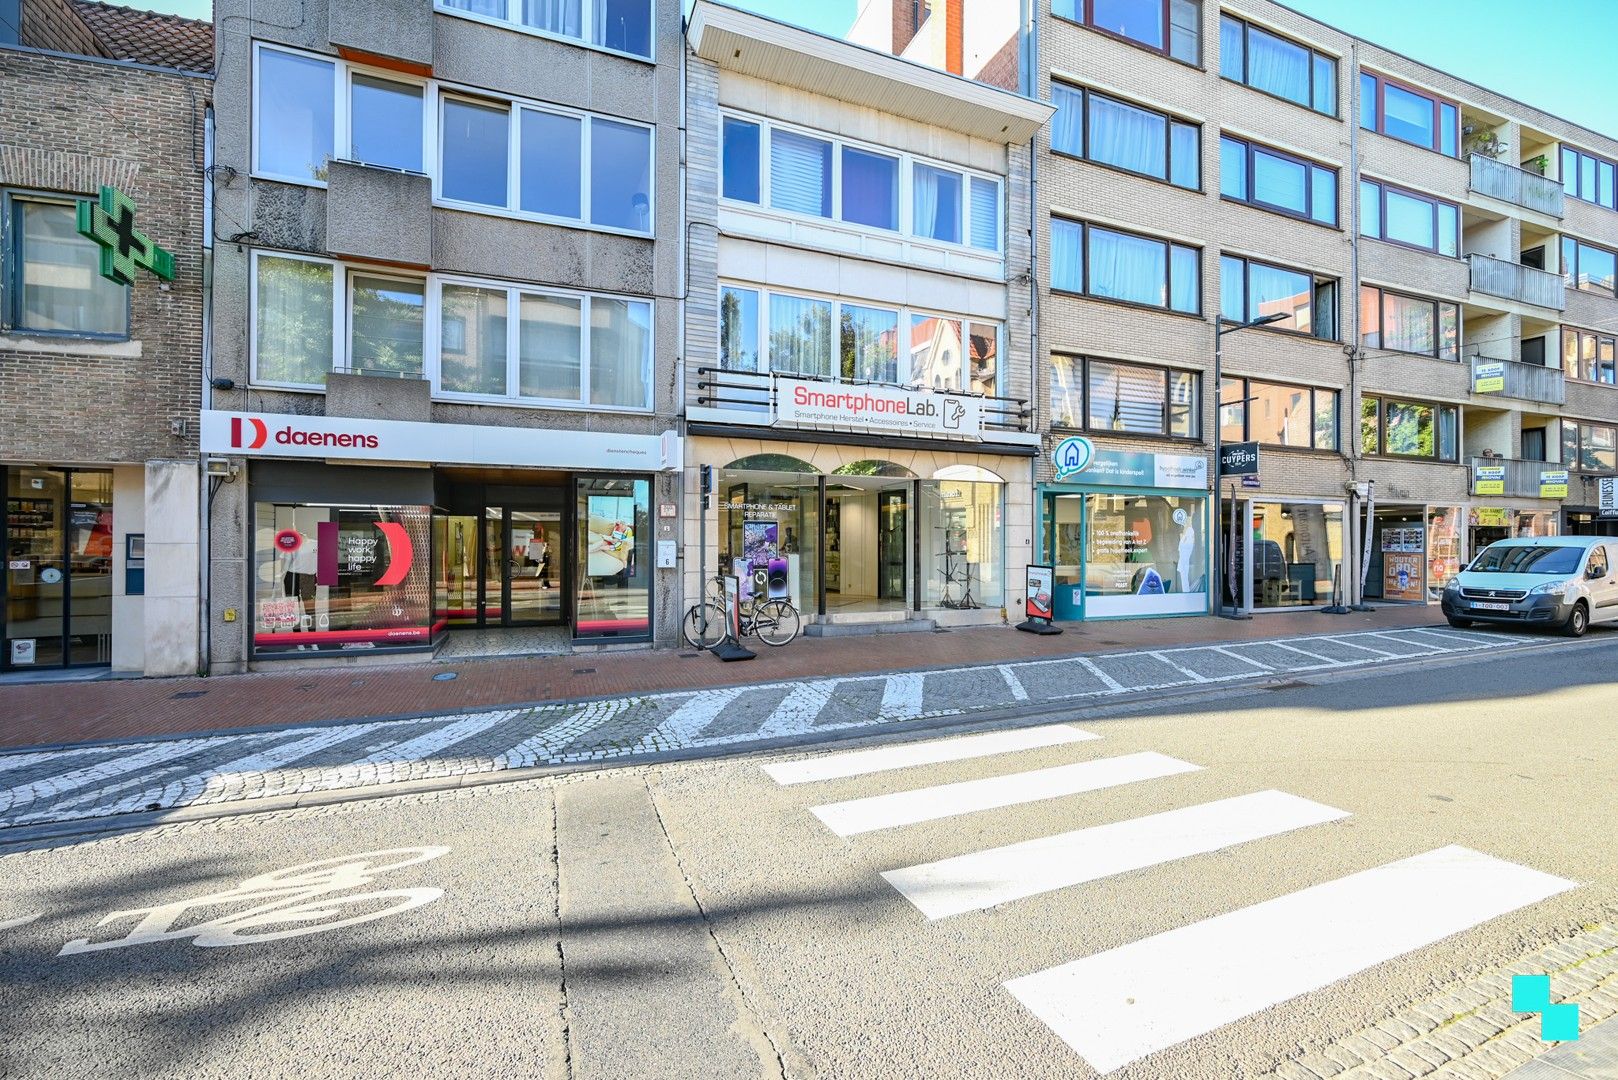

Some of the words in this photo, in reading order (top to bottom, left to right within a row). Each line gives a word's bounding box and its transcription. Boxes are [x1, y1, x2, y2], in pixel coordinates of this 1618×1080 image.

[794, 386, 939, 417] SmartphoneLab.
[794, 410, 838, 421] Smartphone
[839, 414, 864, 423] Herstel
[869, 417, 909, 427] Accessoires
[913, 420, 936, 429] Service
[275, 426, 379, 449] daenens
[1221, 453, 1256, 464] CUYPERS
[1601, 477, 1614, 508] JEUNESSE
[348, 537, 379, 548] Happy
[348, 546, 374, 555] work,
[348, 554, 377, 564] happy
